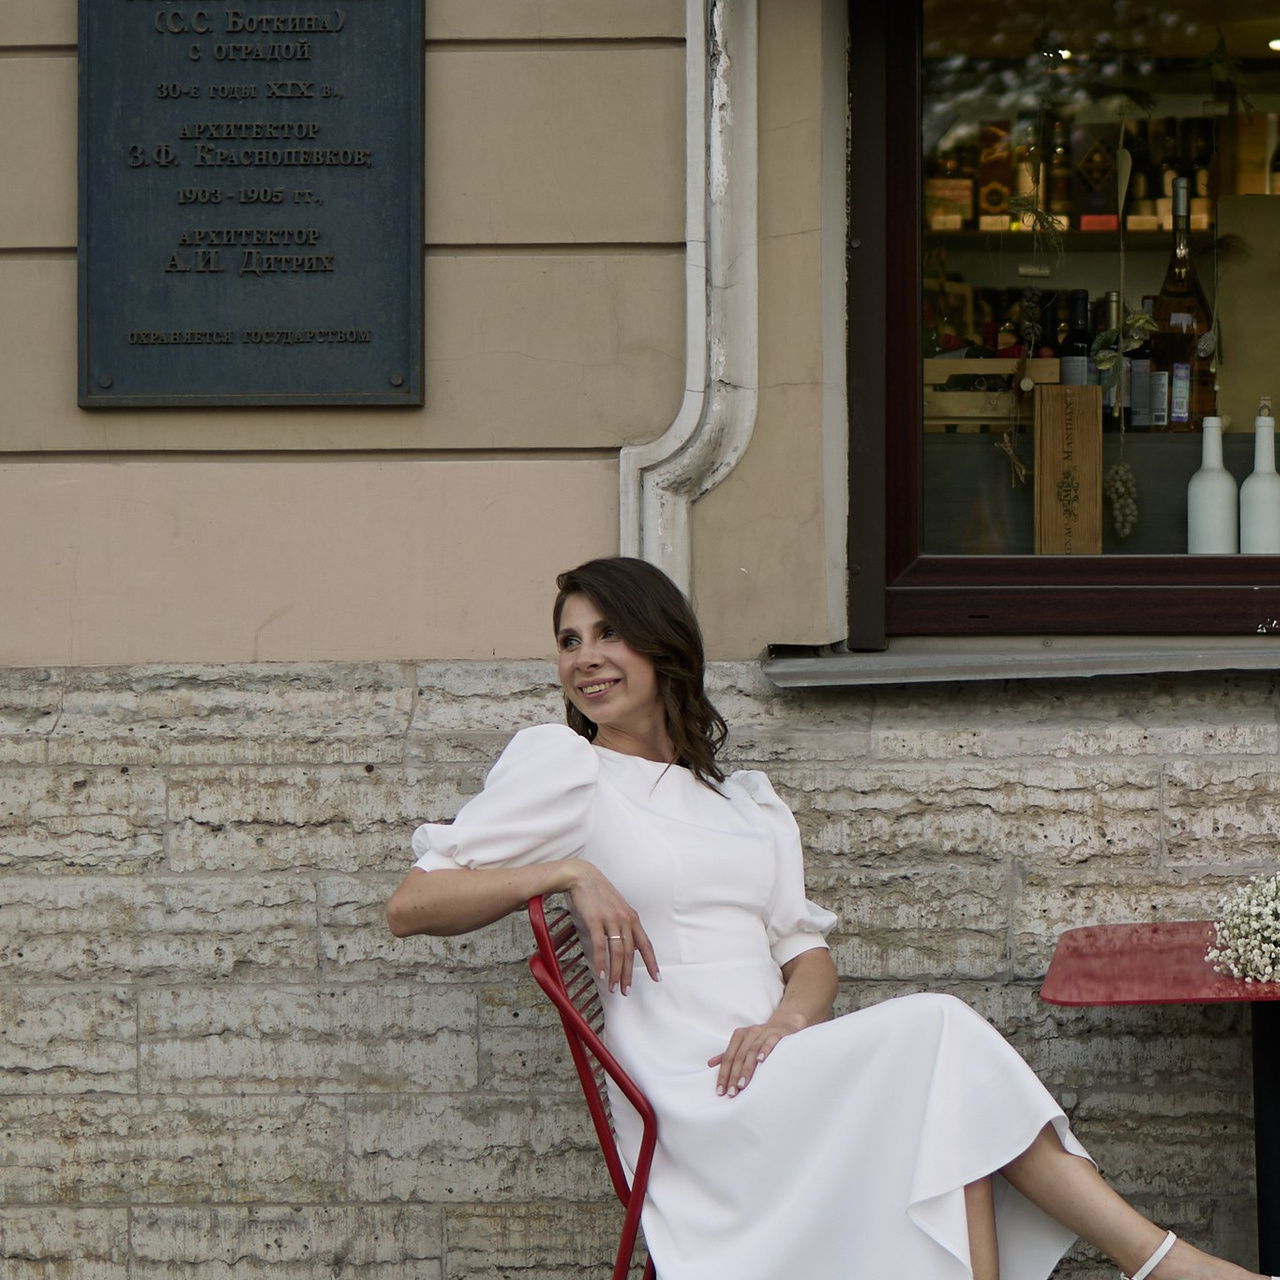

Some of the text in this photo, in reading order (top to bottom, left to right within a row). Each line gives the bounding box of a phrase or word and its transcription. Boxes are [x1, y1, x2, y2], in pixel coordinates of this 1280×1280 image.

[179, 122, 320, 140] АРХИТЕКТОР
[178, 229, 321, 246] АРХИТЕКТОР
[128, 329, 371, 346] ОХРАНЯЕТСЯ ГОСУДАРСТВОМ
